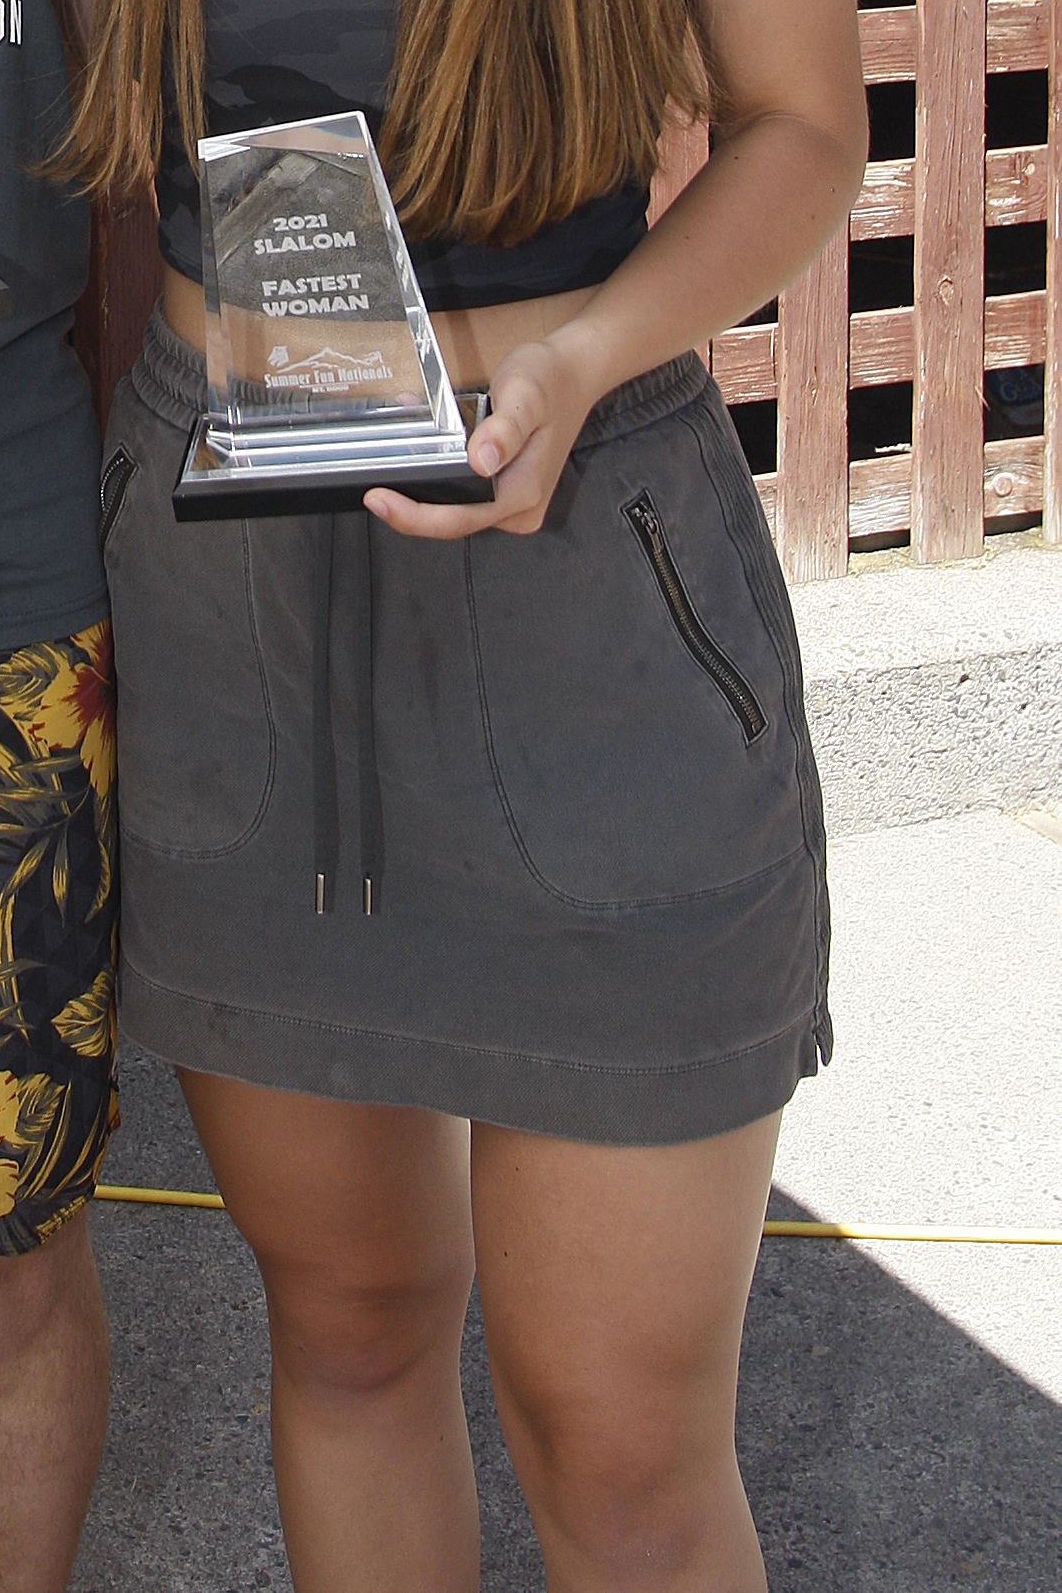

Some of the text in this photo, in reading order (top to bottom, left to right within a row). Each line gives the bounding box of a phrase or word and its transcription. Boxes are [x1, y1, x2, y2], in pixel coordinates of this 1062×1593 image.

[273, 213, 328, 232] 2021
[254, 231, 356, 255] SLALOM
[262, 273, 362, 297] FASTEST
[262, 294, 369, 317] WOMAN
[264, 365, 394, 389] Summer Fun Nationals
